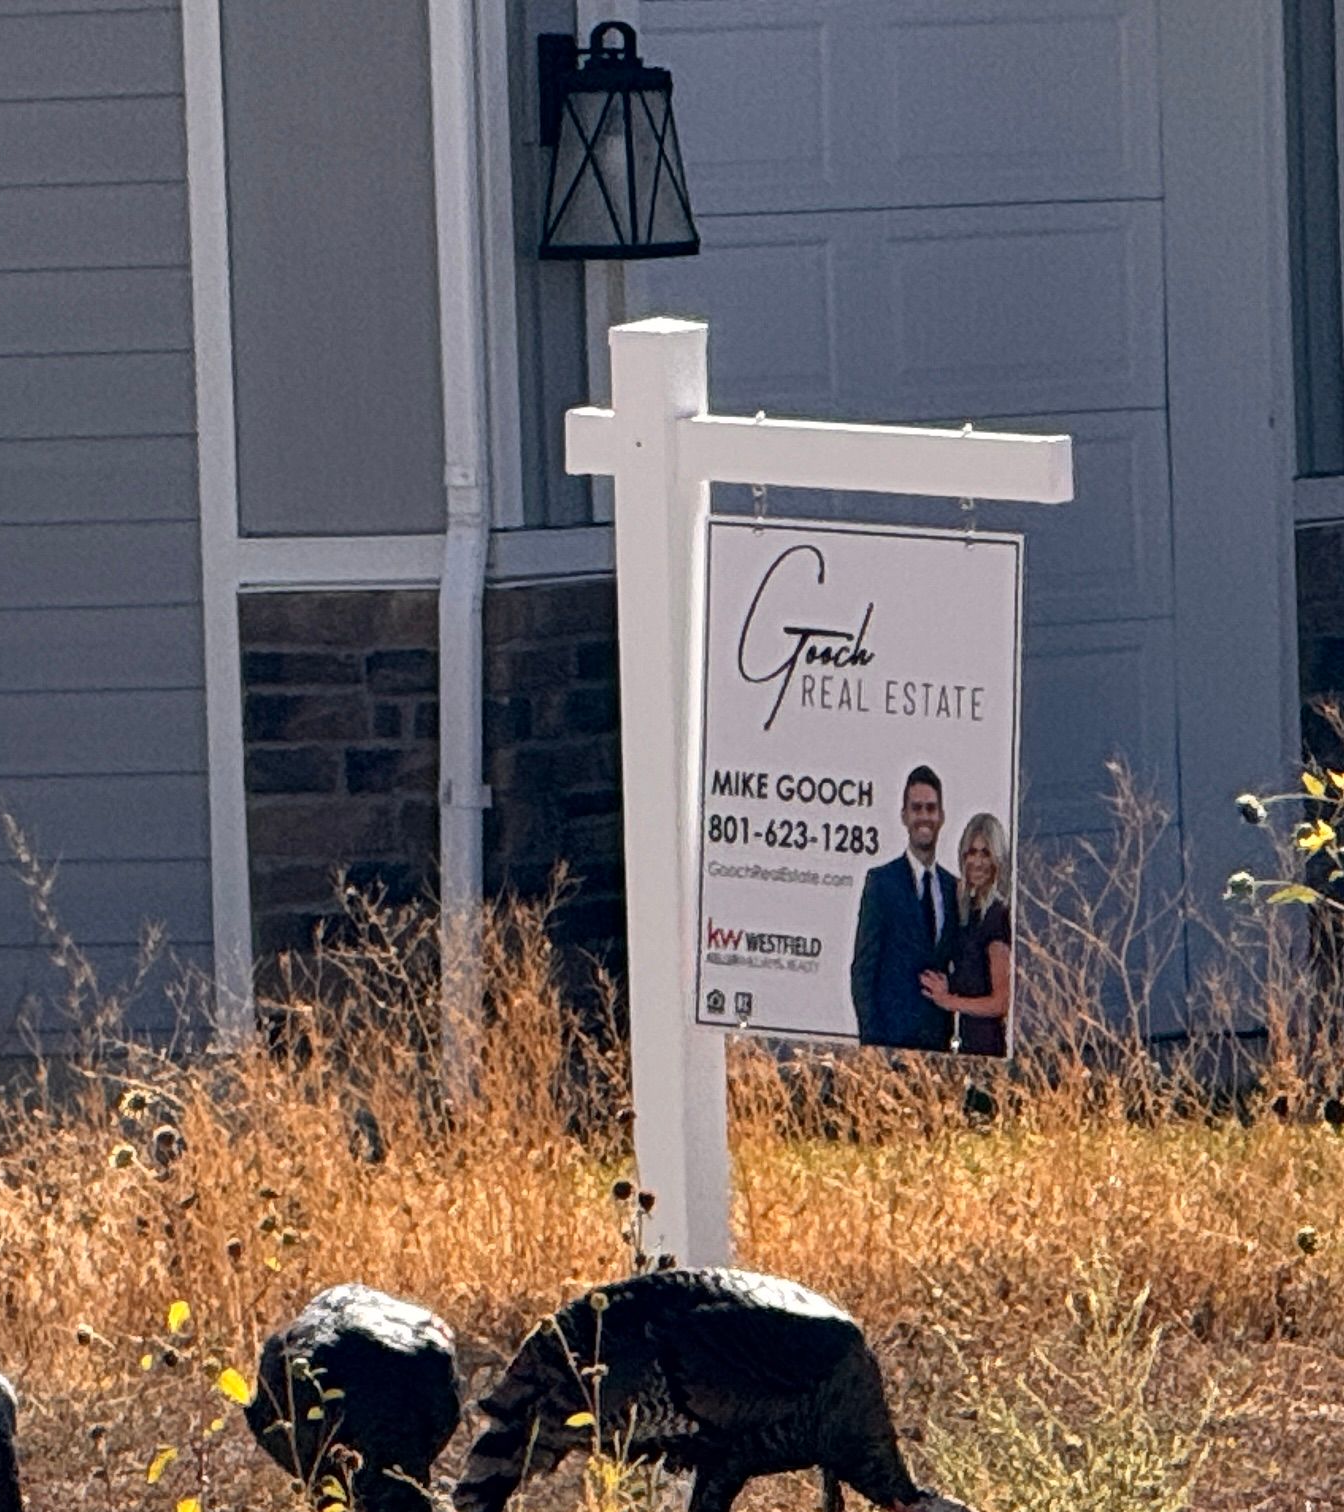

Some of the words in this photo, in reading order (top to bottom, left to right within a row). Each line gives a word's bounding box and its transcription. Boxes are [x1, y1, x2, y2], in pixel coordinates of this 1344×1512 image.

[738, 544, 875, 731] Gooch
[801, 674, 869, 712] REAL
[885, 680, 984, 722] ESTATE
[711, 769, 768, 799] MIKE
[776, 774, 873, 807] GOOCH
[708, 814, 879, 855] 801-623-1283
[745, 932, 822, 957] WESTFIELD
